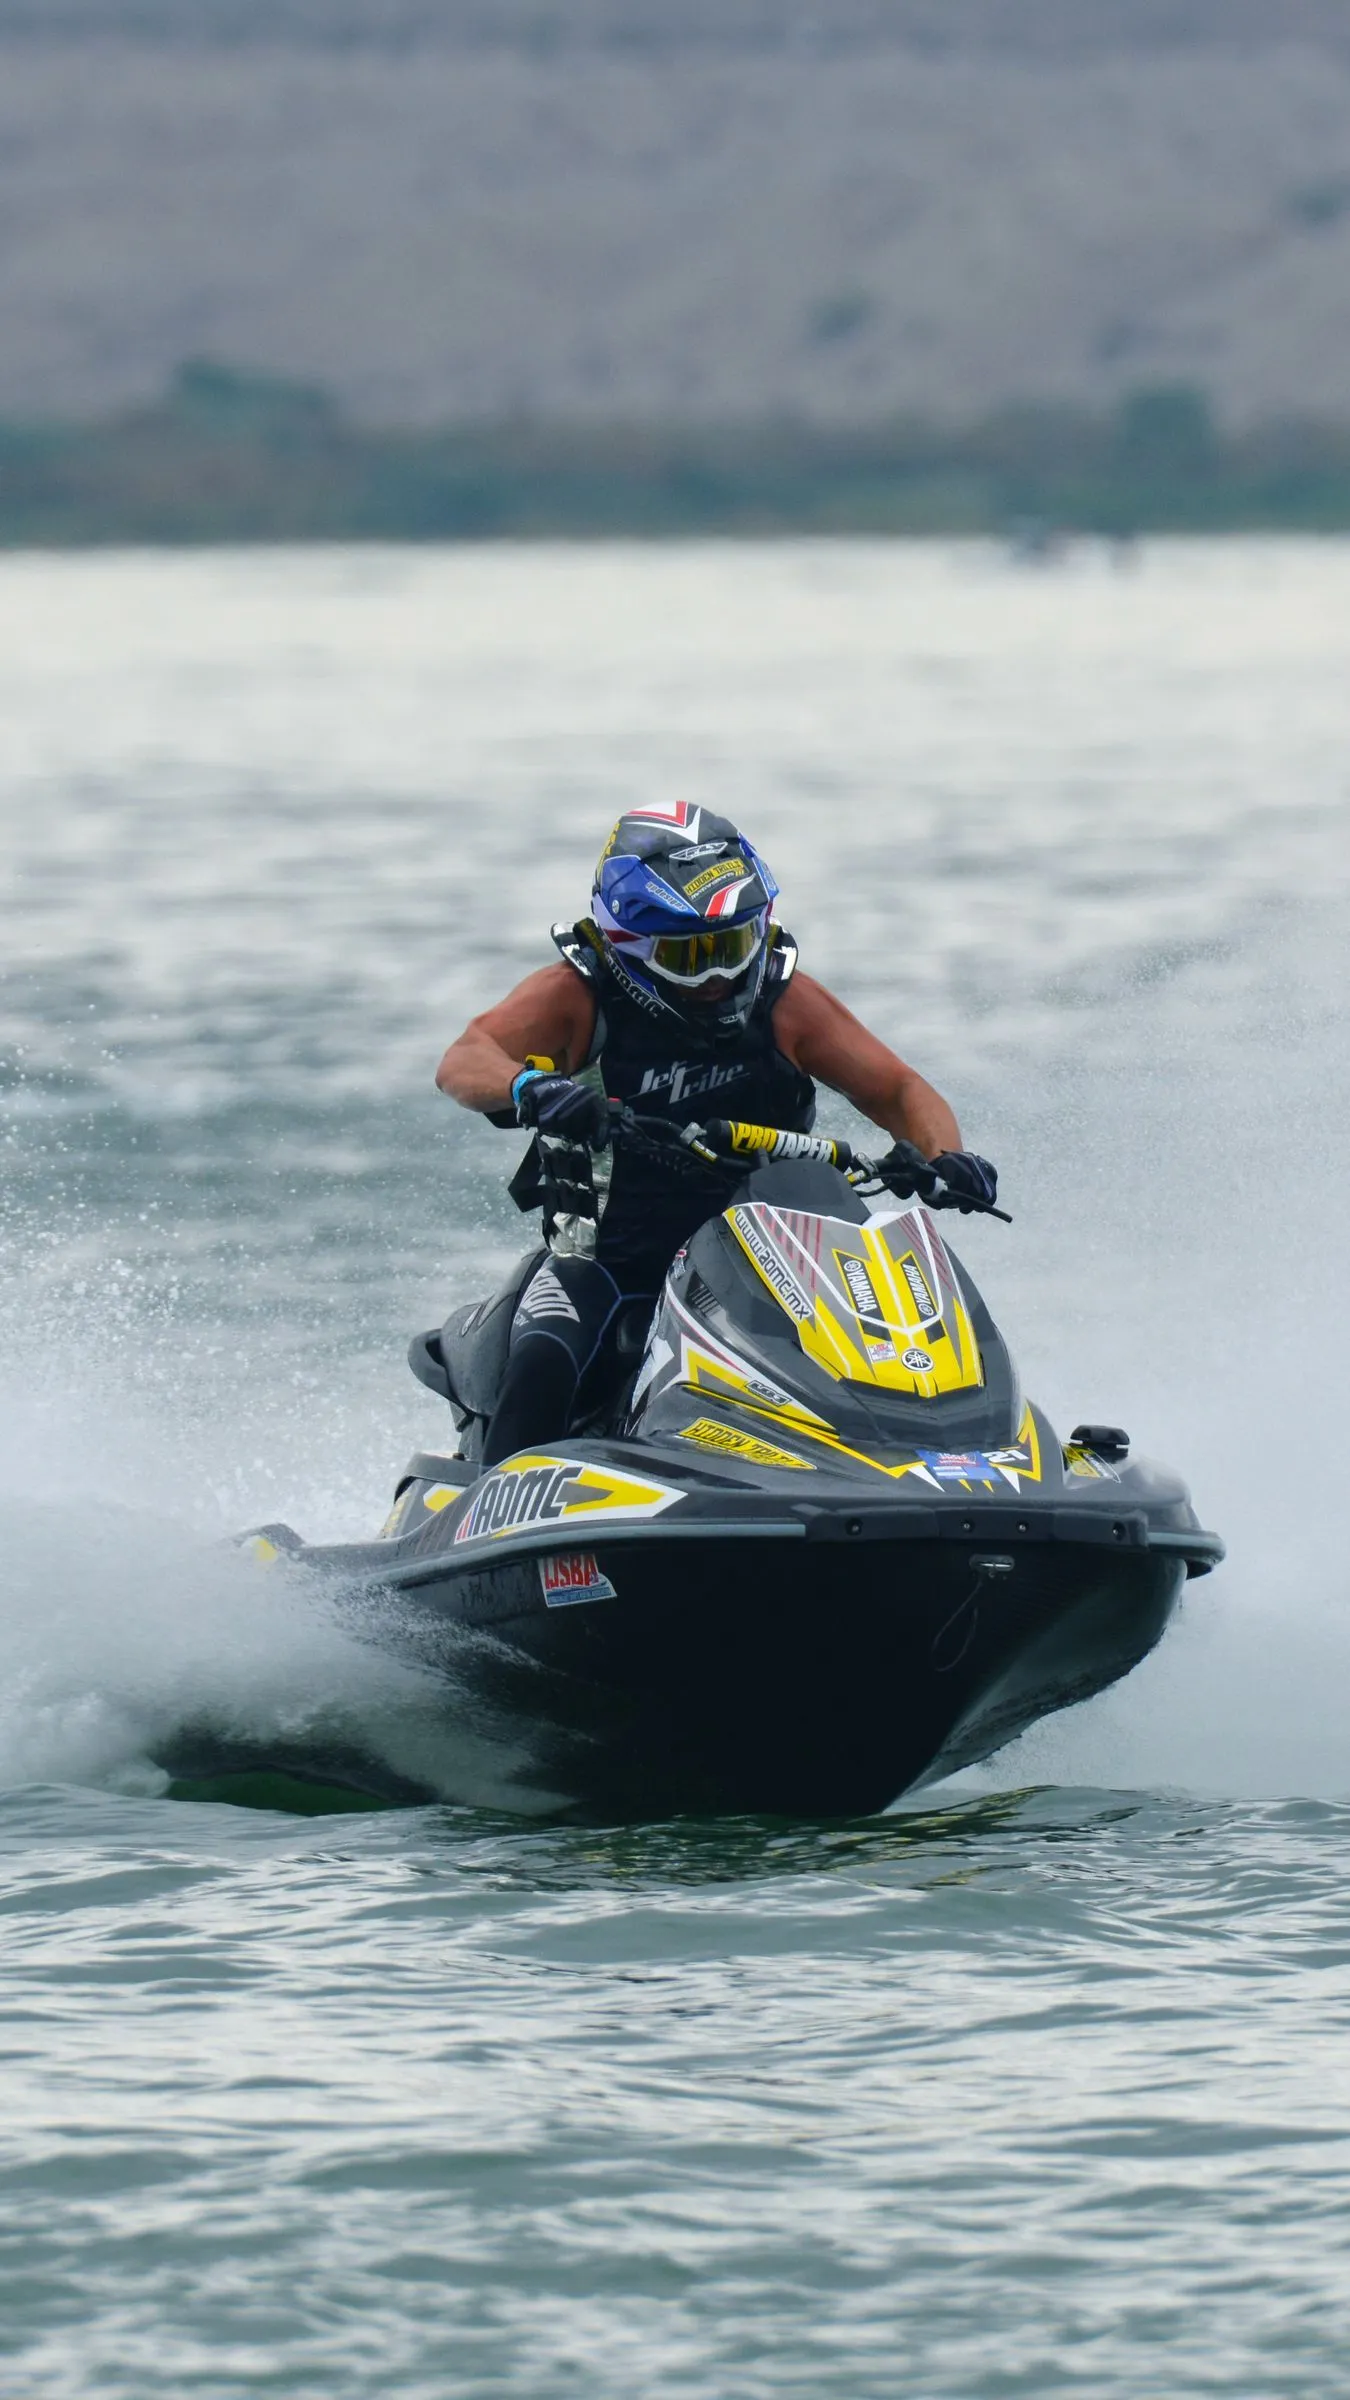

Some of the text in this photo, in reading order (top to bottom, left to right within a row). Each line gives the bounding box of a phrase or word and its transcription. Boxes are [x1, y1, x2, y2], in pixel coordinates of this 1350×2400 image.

[685, 871, 714, 895] HIDDEN
[846, 1268, 878, 1313] YAMAHA
[902, 1263, 932, 1305] YAMAHA
[687, 1421, 749, 1448] HIDDEN
[471, 1465, 585, 1537] AOMC
